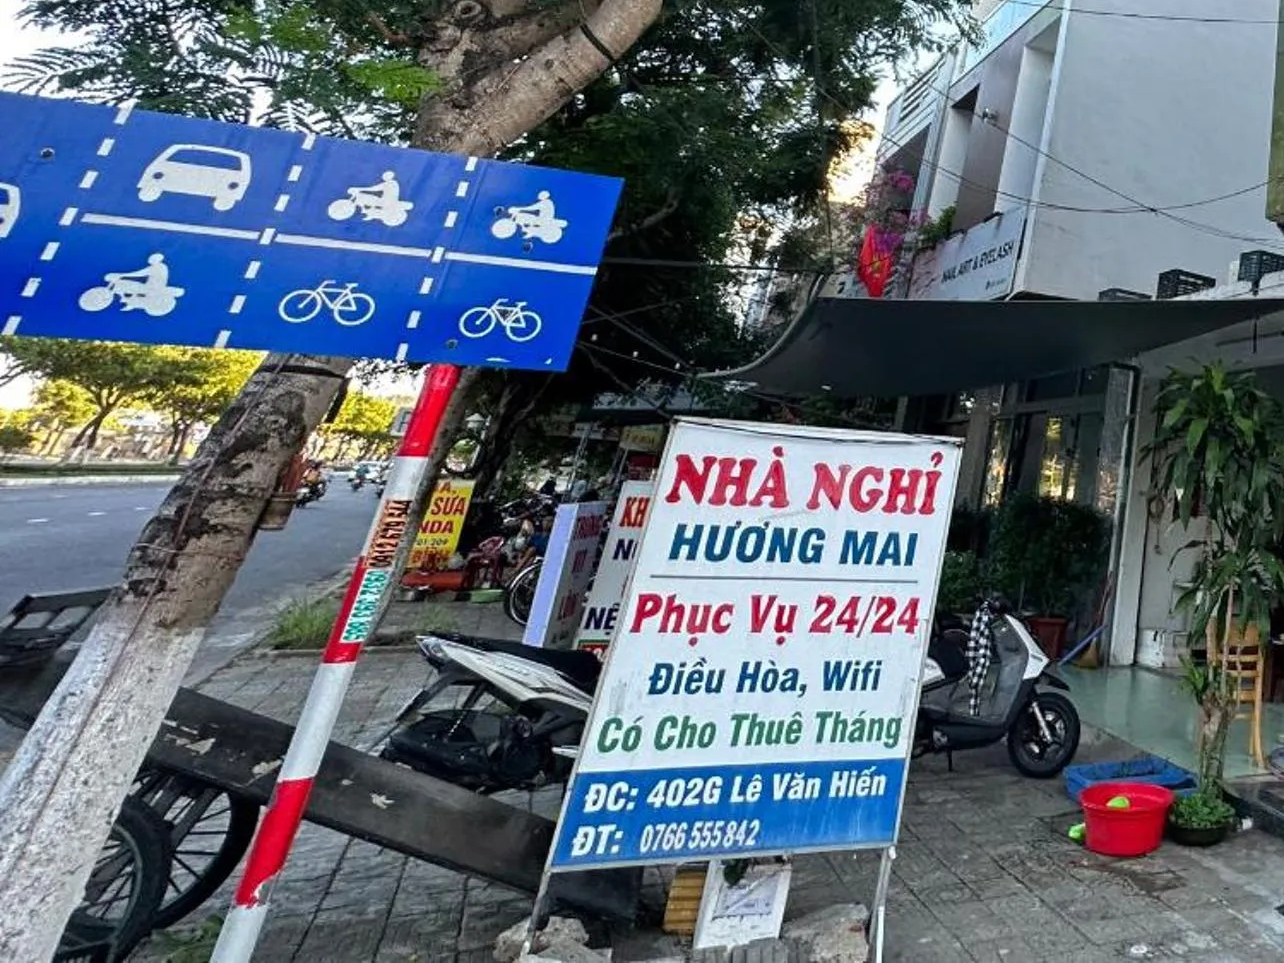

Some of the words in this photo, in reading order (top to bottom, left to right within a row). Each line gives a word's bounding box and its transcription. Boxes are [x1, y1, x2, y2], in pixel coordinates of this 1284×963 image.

[665, 446, 790, 508] NHÀ
[807, 452, 942, 515] NGHỈ
[668, 521, 826, 565] HƯƠNG
[838, 529, 918, 567] MAI
[630, 593, 735, 647] Phục
[751, 594, 798, 645] Vụ
[808, 595, 920, 638] 24/24
[648, 657, 726, 695] Điều
[735, 659, 808, 698] Hòa,
[822, 660, 883, 692] Wifi
[597, 715, 644, 753] Có
[653, 715, 717, 750] Cho
[730, 711, 804, 748] Thuê
[815, 709, 902, 749] Tháng
[583, 782, 639, 813] ĐC:
[646, 776, 723, 809] 402G
[730, 774, 762, 803] Lê
[772, 772, 820, 801] Văn
[828, 765, 887, 798] Hiến
[571, 826, 624, 857] ĐT:
